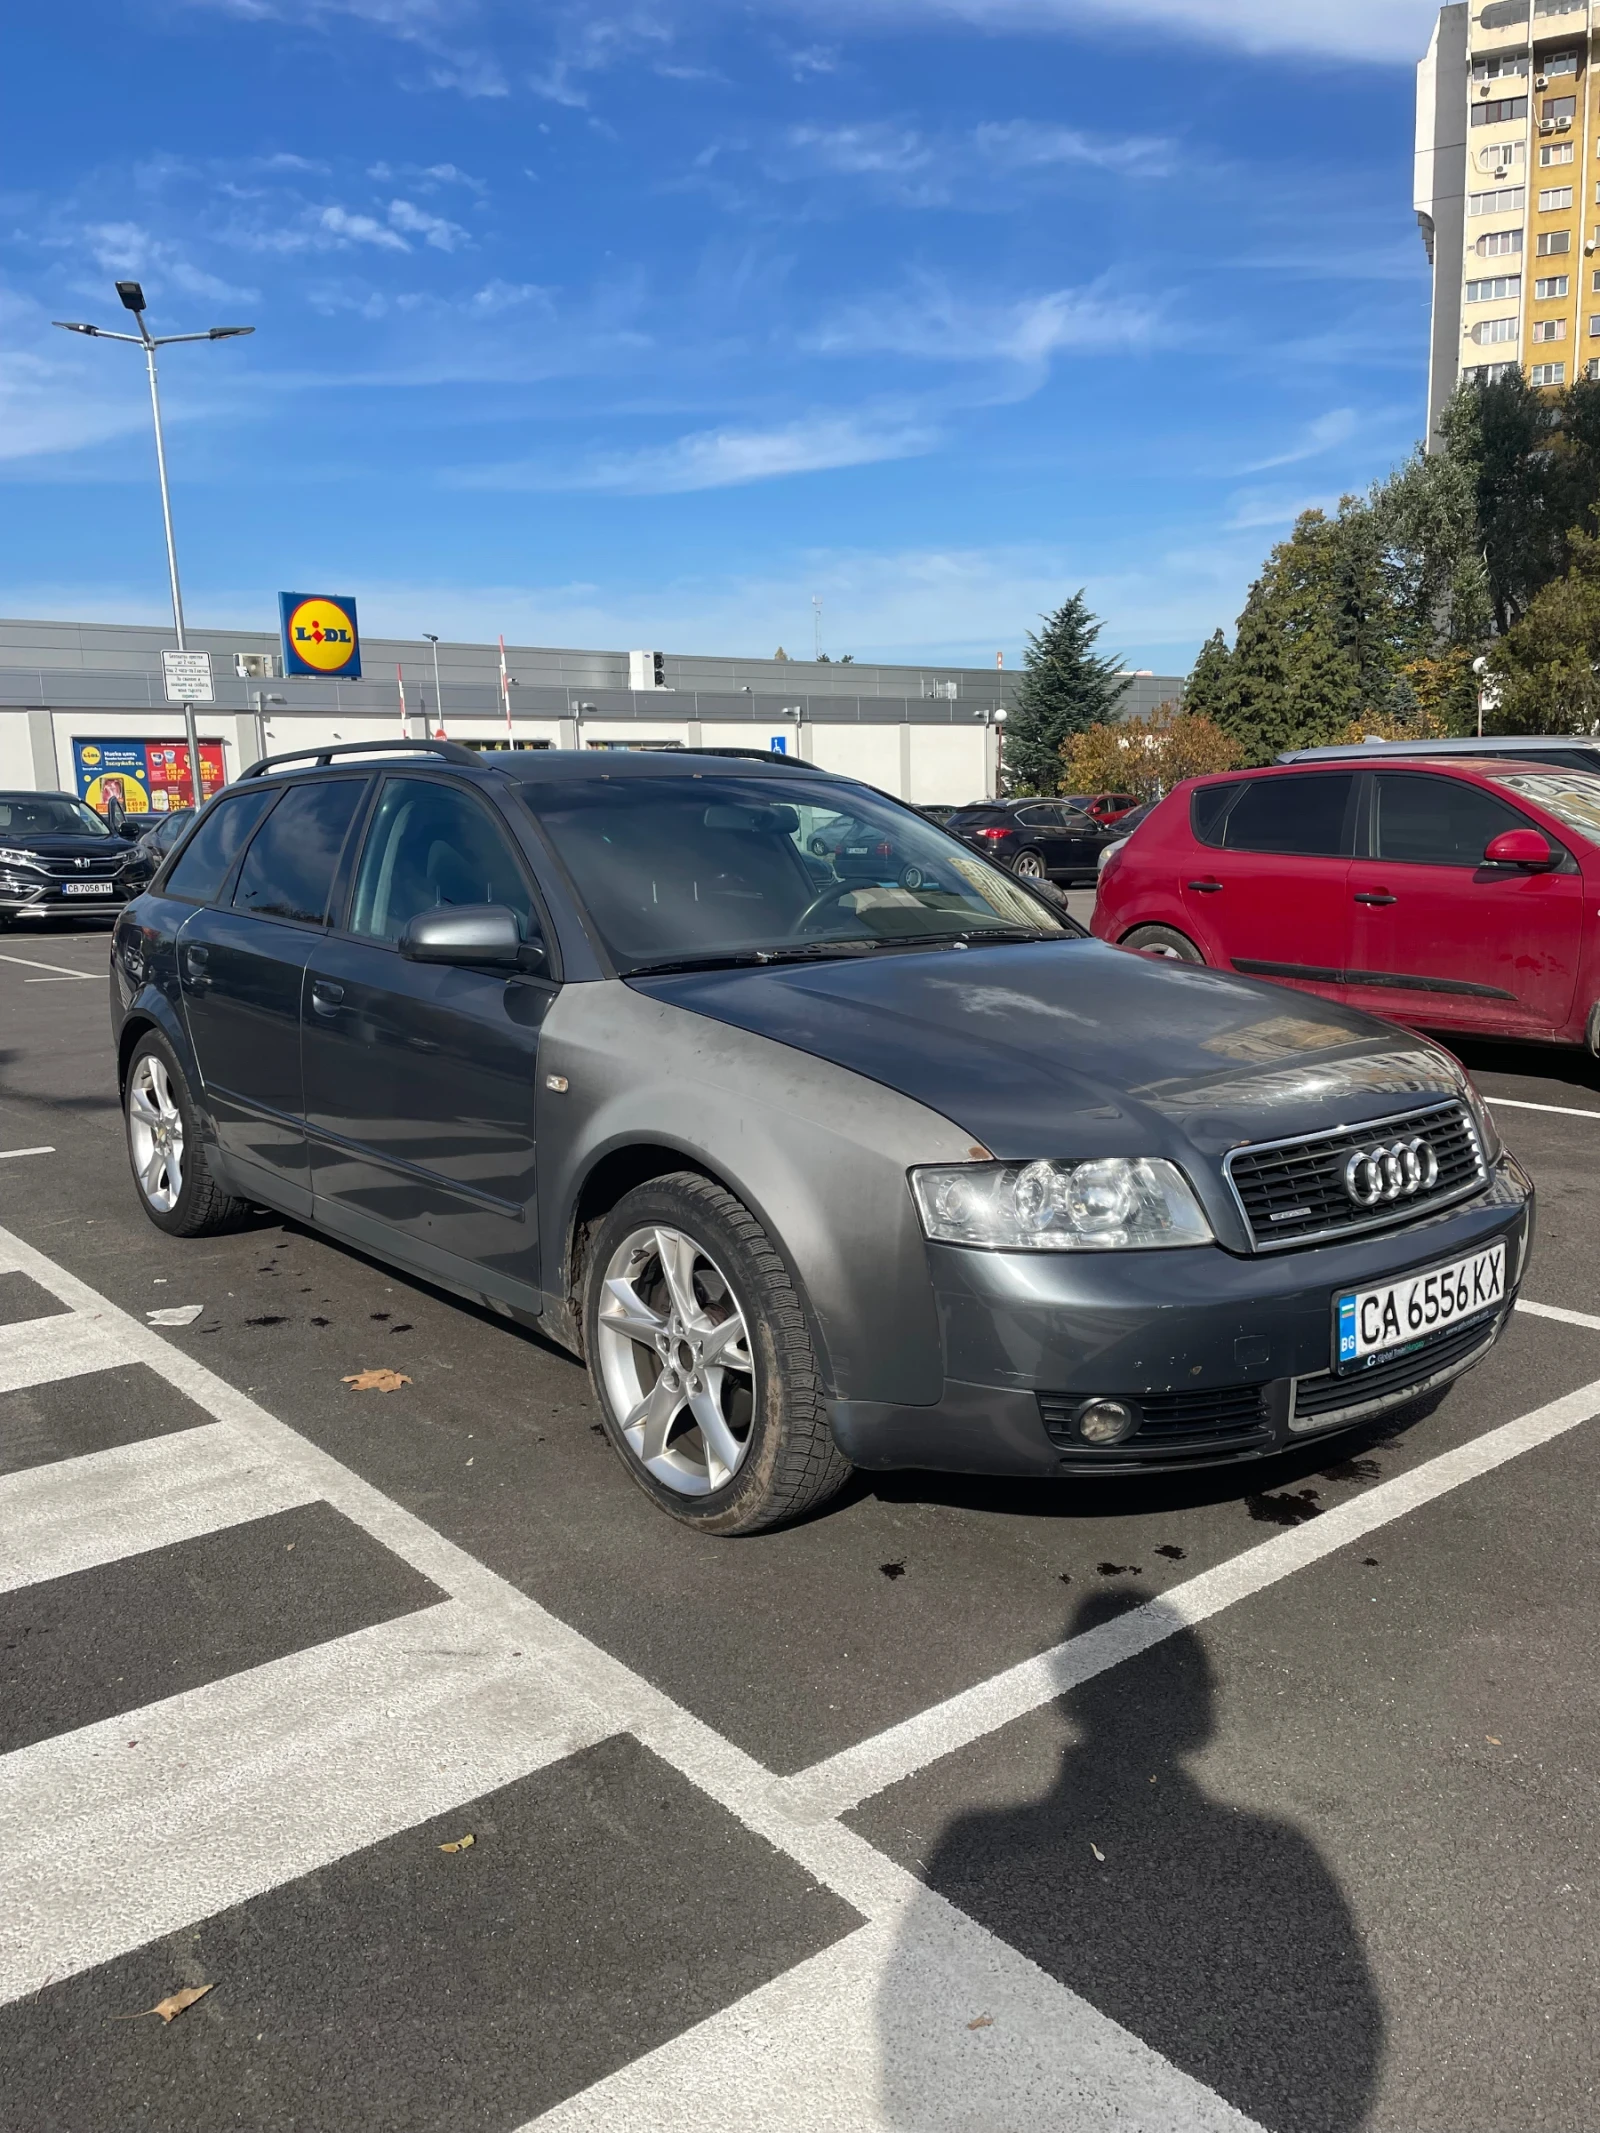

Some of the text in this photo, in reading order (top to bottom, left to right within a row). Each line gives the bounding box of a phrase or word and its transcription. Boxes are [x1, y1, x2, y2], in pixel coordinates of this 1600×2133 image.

[1361, 1250, 1501, 1344] CA 6556 KX
[1341, 1335, 1354, 1352] BG
